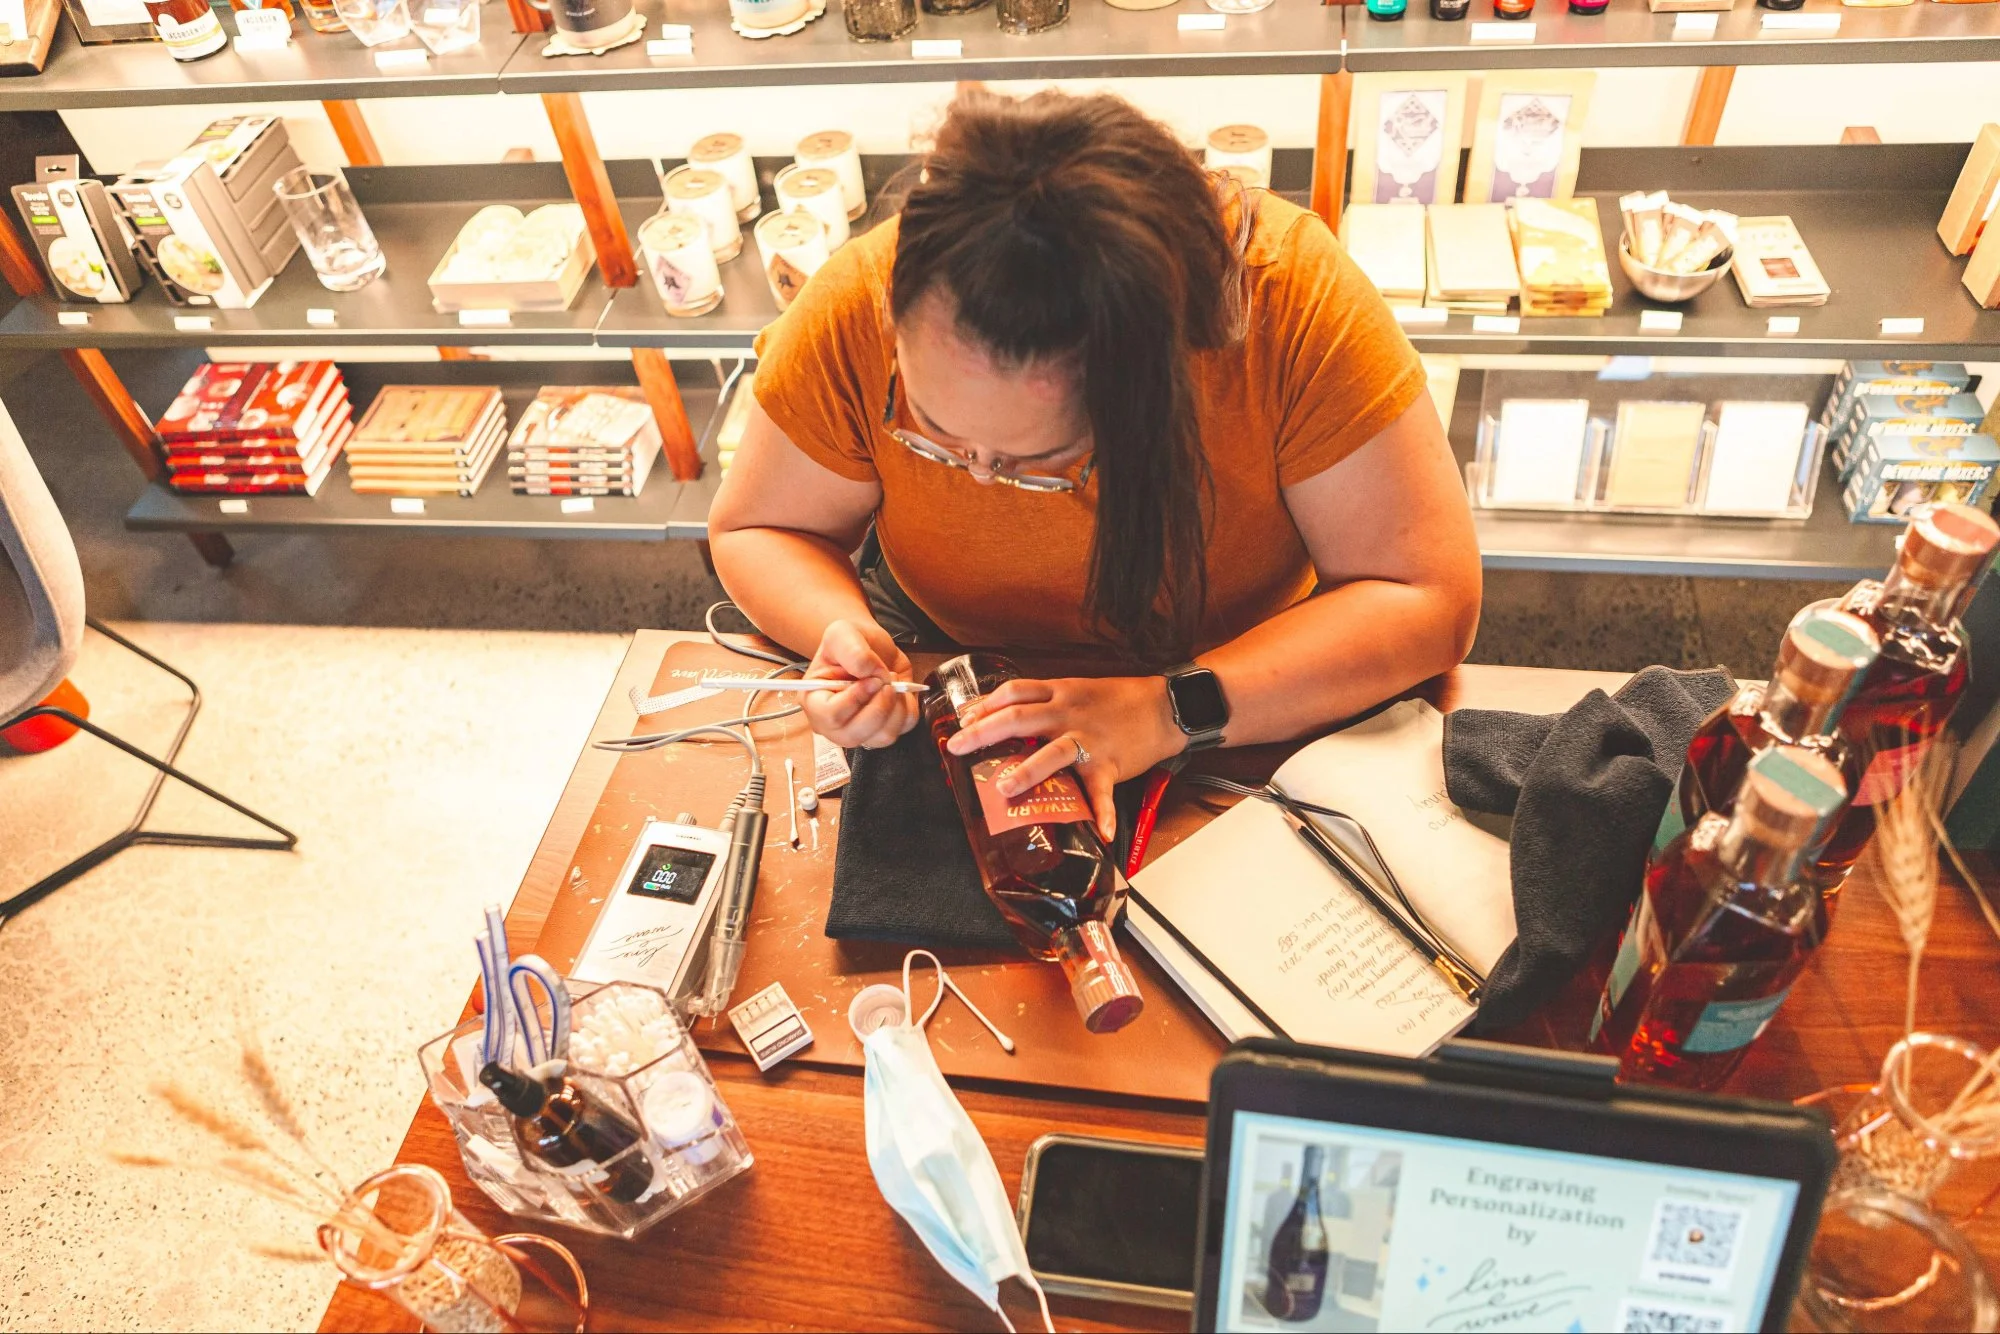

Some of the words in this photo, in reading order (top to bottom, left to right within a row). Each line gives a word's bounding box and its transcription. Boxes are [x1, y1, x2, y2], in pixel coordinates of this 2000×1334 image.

[1880, 464, 1942, 480] BEVERAGE
[1943, 466, 1992, 480] MIXERS
[652, 870, 678, 884] 000
[1301, 923, 1341, 952] Christmas
[776, 1029, 803, 1048] DIAMOND
[1467, 1166, 1598, 1203] Engraving
[1430, 1187, 1625, 1229] Personalization
[1507, 1222, 1536, 1245] by
[1446, 1257, 1567, 1303] line
[1453, 1299, 1573, 1333] wave
